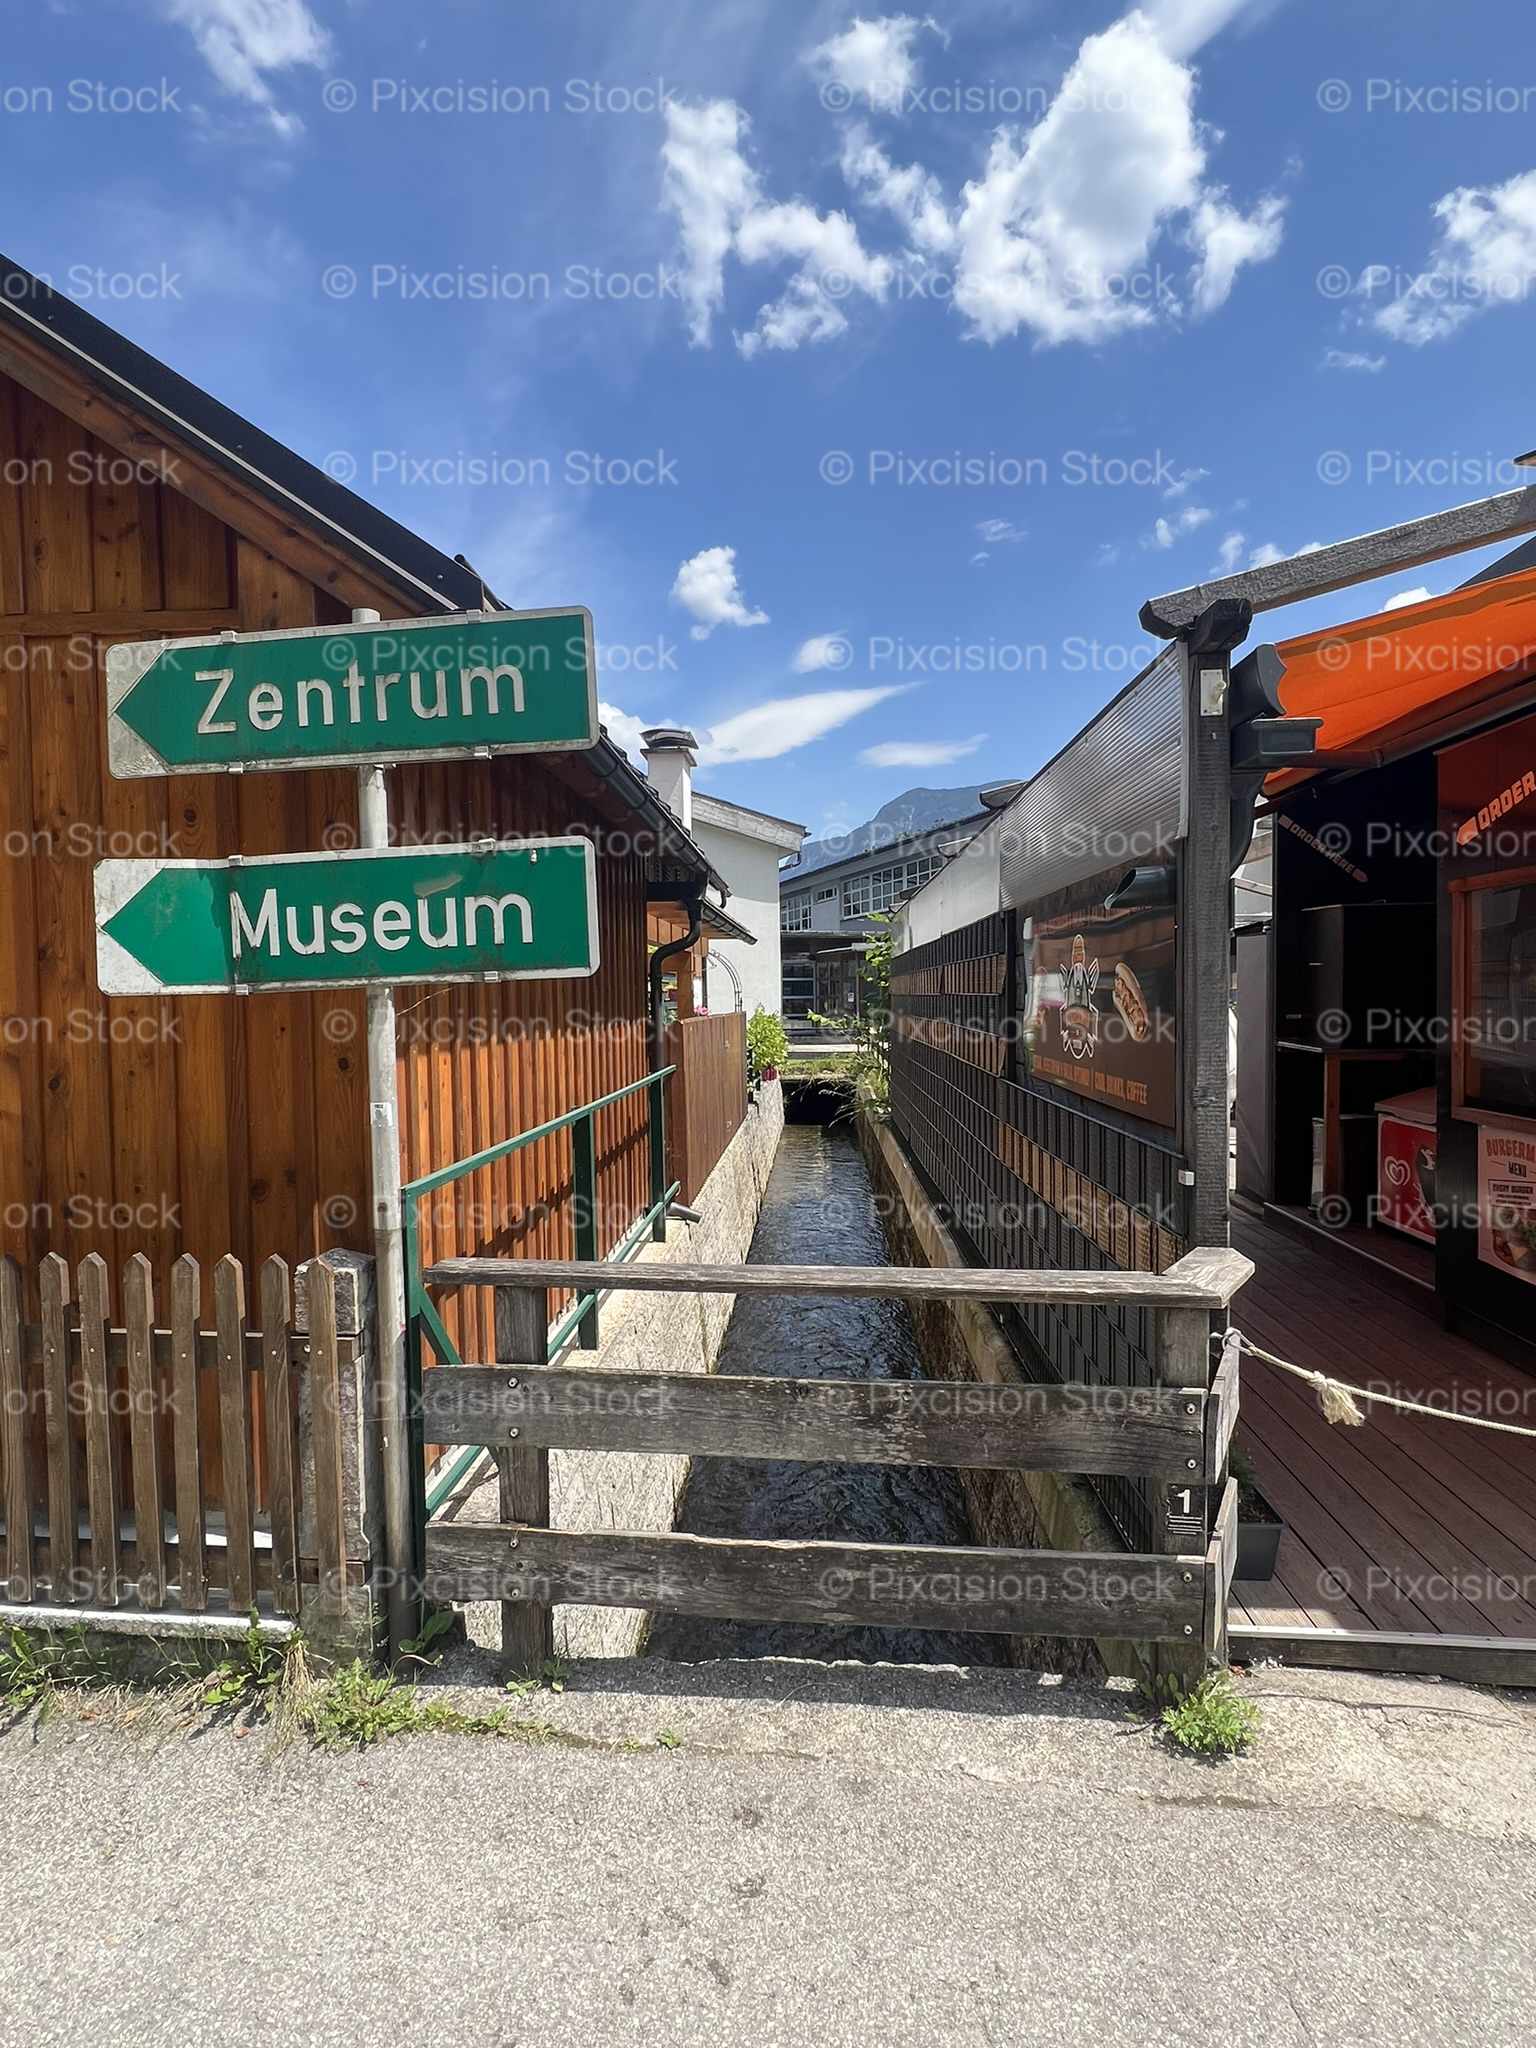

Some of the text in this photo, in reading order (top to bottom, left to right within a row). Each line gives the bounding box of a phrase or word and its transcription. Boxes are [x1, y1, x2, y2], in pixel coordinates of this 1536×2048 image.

[195, 659, 526, 735] Zentrum
[1477, 771, 1536, 830] ORDER
[1289, 823, 1328, 854] ORDER
[230, 888, 534, 960] Museum
[1176, 1489, 1191, 1514] 1
